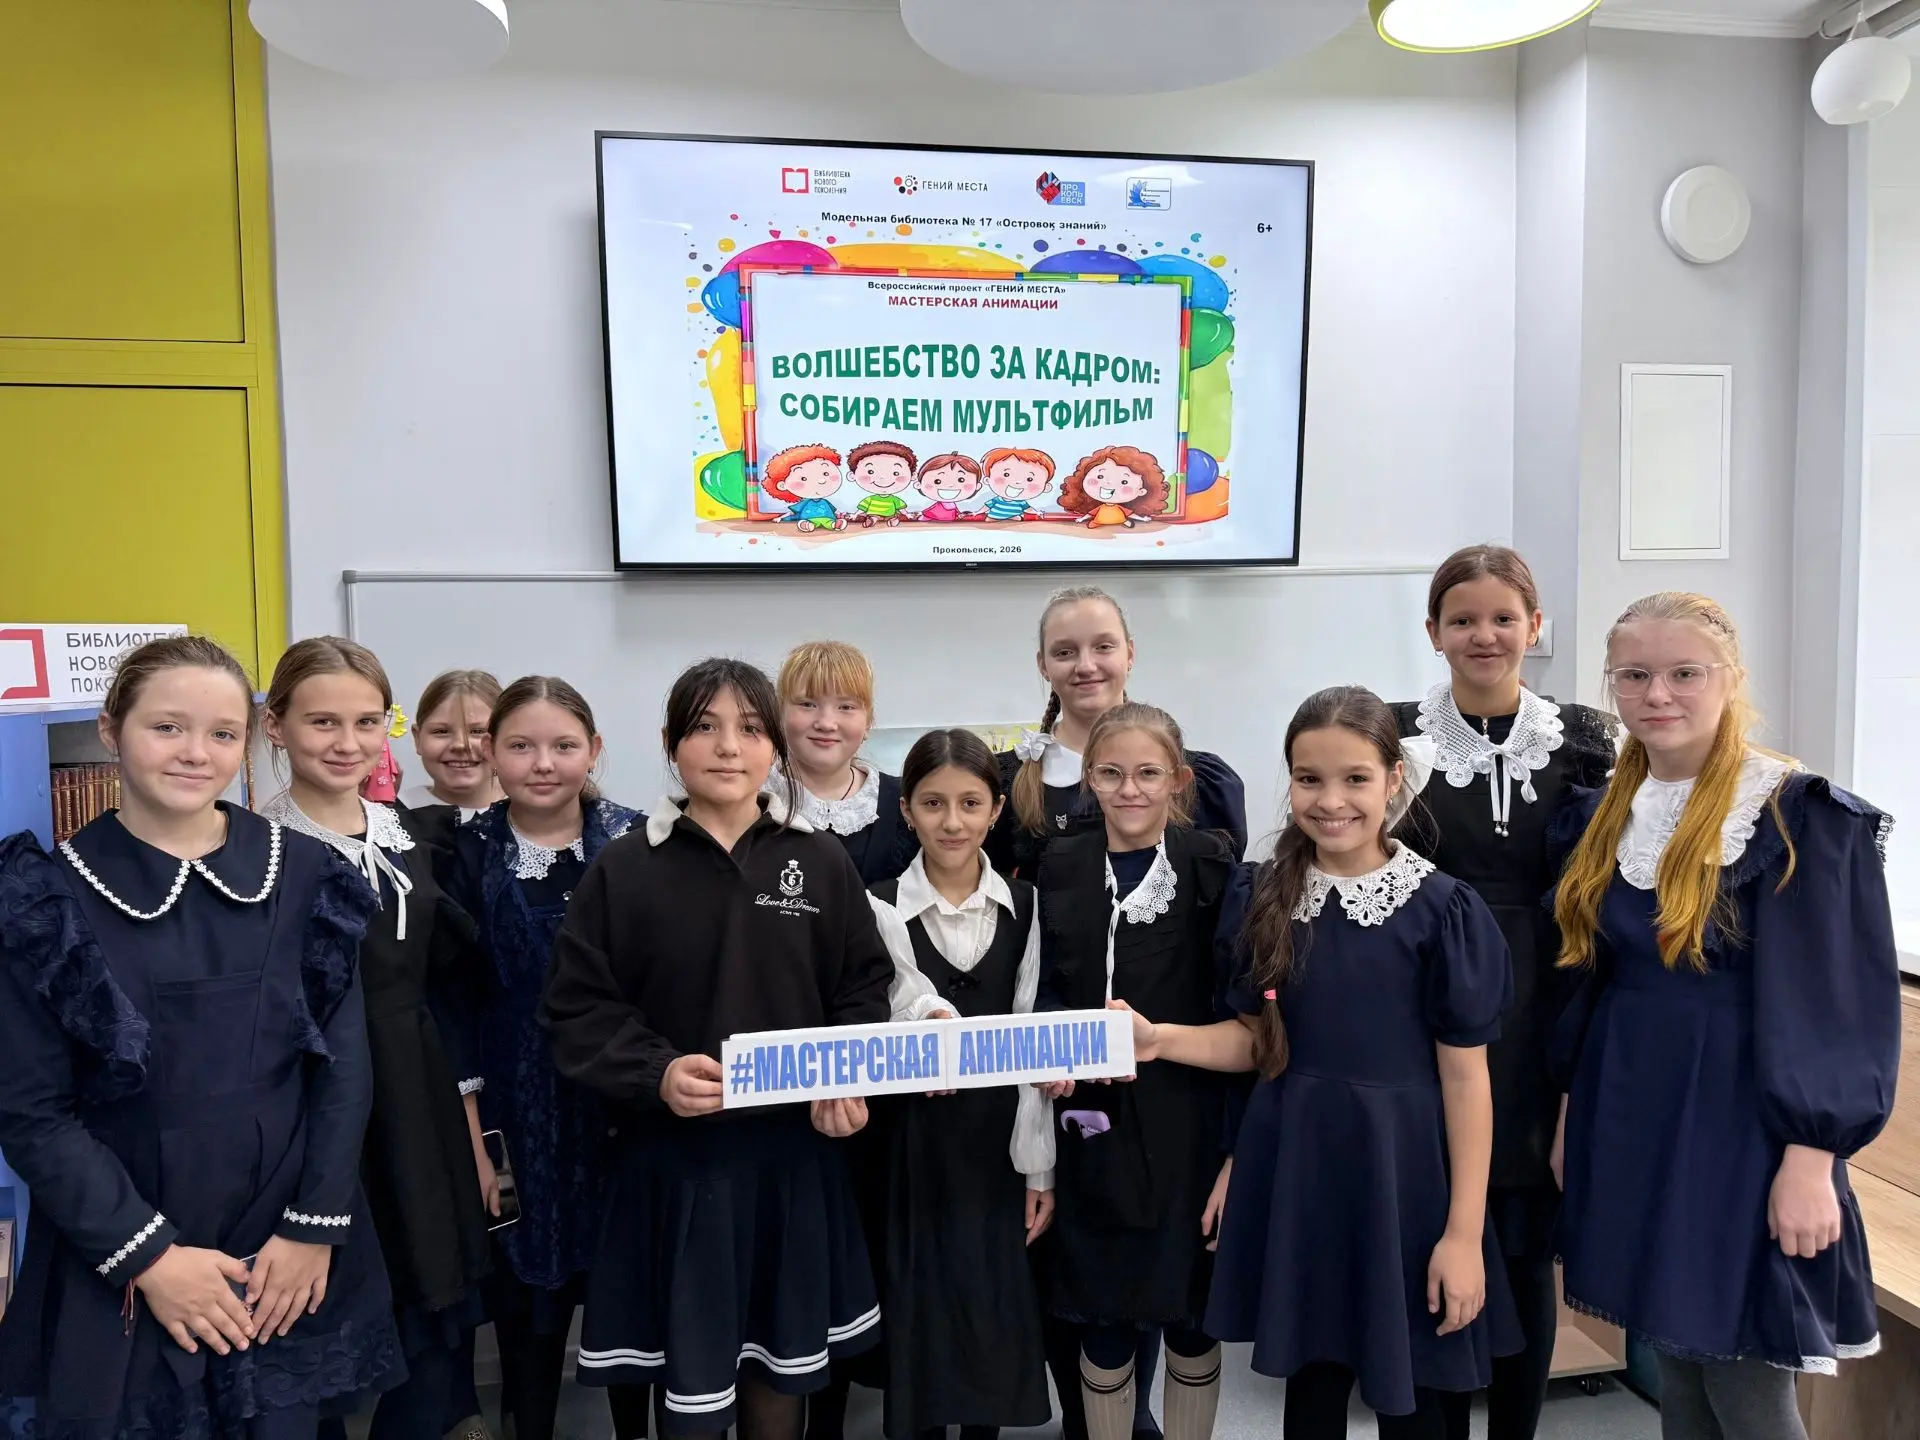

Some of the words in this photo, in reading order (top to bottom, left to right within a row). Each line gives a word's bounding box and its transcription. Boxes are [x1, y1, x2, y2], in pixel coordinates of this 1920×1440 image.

[922, 180, 953, 191] ГЕНИЙ
[957, 181, 988, 192] МЕСТА
[821, 212, 887, 222] Модельная
[890, 214, 959, 226] библиотека
[962, 217, 975, 226] №
[979, 217, 992, 227] 17
[1059, 221, 1107, 231] знаний»
[1257, 222, 1273, 234] 6+
[868, 281, 946, 292] Всероссийский
[949, 284, 982, 294] проект
[985, 284, 1024, 294] «ГЕНИЙ
[1027, 285, 1066, 295] МЕСТА»
[888, 295, 978, 309] МАСТЕРСКАЯ
[982, 299, 1058, 311] АНИМАЦИИ
[772, 344, 980, 379] ВОЛШЕБСТВО
[989, 345, 1026, 380] ЗА
[1035, 347, 1161, 387] КАДРОМ:
[780, 392, 943, 433] СОБИРАЕМ
[953, 397, 1153, 434] МУЛЬТФИЛЬМ
[933, 546, 997, 554] Прокопьевск,
[1000, 545, 1022, 554] 2026
[66, 632, 186, 648] БИБЛИОТ
[69, 655, 122, 671] НОВО
[730, 1032, 940, 1095] #МАСТЕРСКАЯ
[959, 1020, 1108, 1076] АНИМАЦИИ
